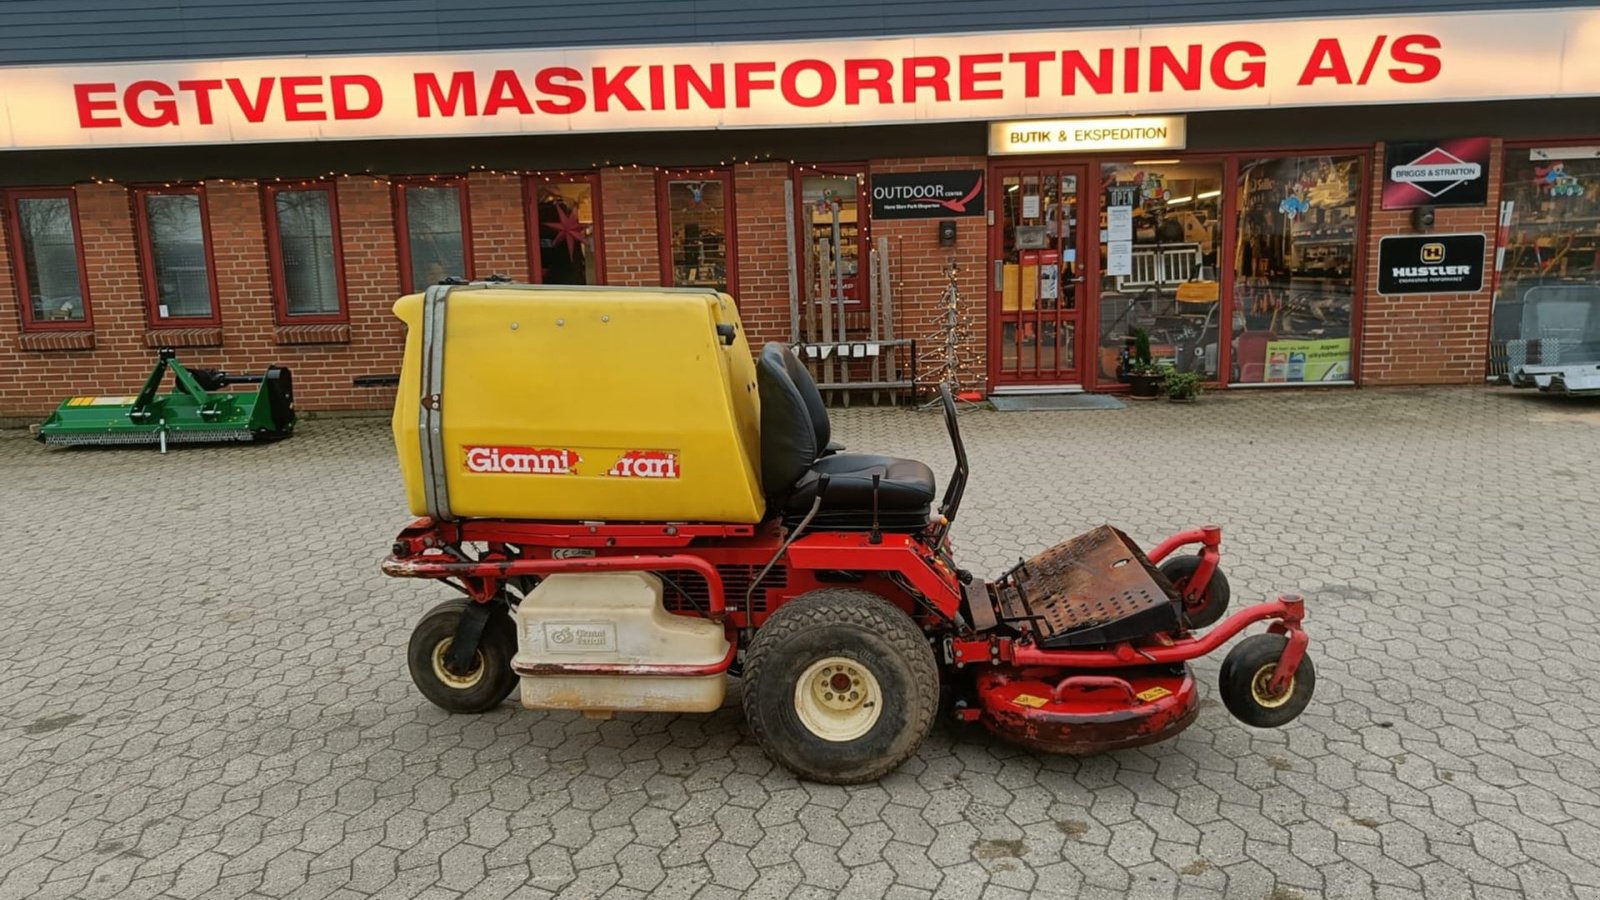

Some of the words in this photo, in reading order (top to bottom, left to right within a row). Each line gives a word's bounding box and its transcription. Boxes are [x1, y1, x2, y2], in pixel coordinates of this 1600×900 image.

[74, 75, 382, 128] EGTVED
[414, 41, 1265, 117] MASKINFORRETNING
[1298, 35, 1441, 86] A/S
[1010, 131, 1051, 144] BUTIK
[1058, 130, 1067, 142] &
[1075, 127, 1167, 142] EKSPEDITION
[1396, 169, 1426, 178] BRIGGS
[1427, 169, 1434, 177] &
[1434, 168, 1476, 177] STRATTON
[873, 184, 944, 200] OUTDOOR
[1392, 265, 1470, 277] HUSTLER
[467, 448, 570, 473] Gianni
